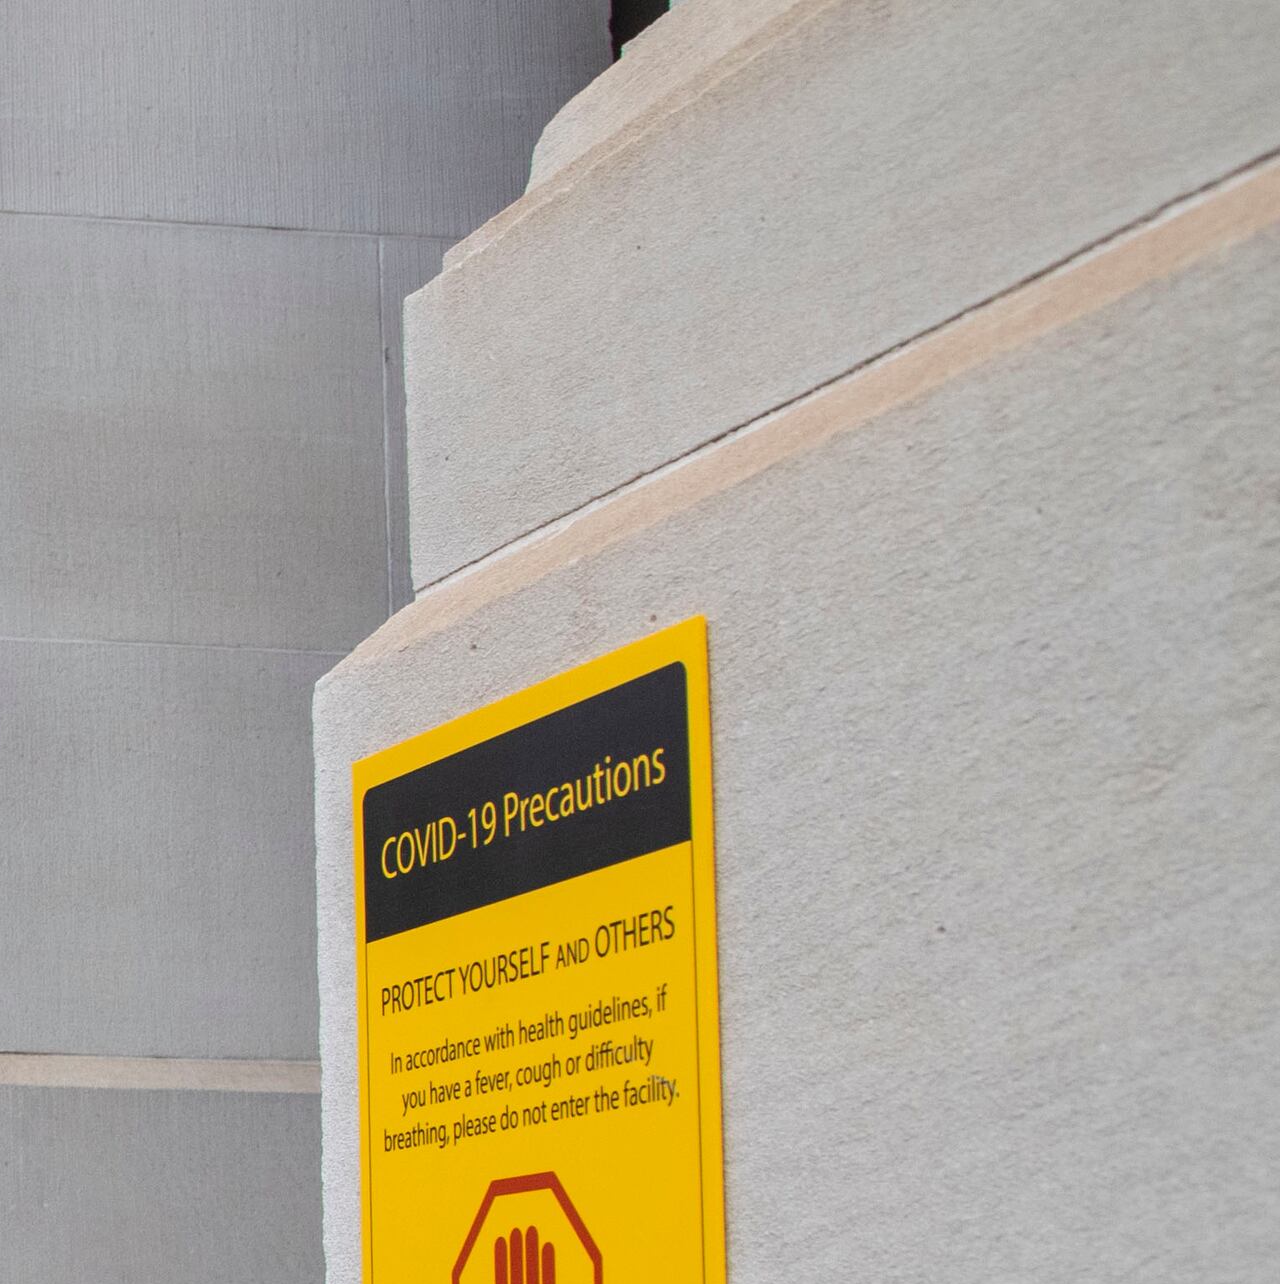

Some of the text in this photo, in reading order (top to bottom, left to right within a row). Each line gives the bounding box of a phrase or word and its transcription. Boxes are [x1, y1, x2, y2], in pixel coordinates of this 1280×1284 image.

[381, 748, 666, 878] COVID-19 Precautions
[382, 906, 675, 1016] PROTECT YOURSELF AND OTHERS
[391, 983, 667, 1074] In accordance with health guidelines, if
[384, 1074, 680, 1152] breathing, please do not enter the facility.
[402, 1035, 653, 1116] you have a fever, cough or difficulty
